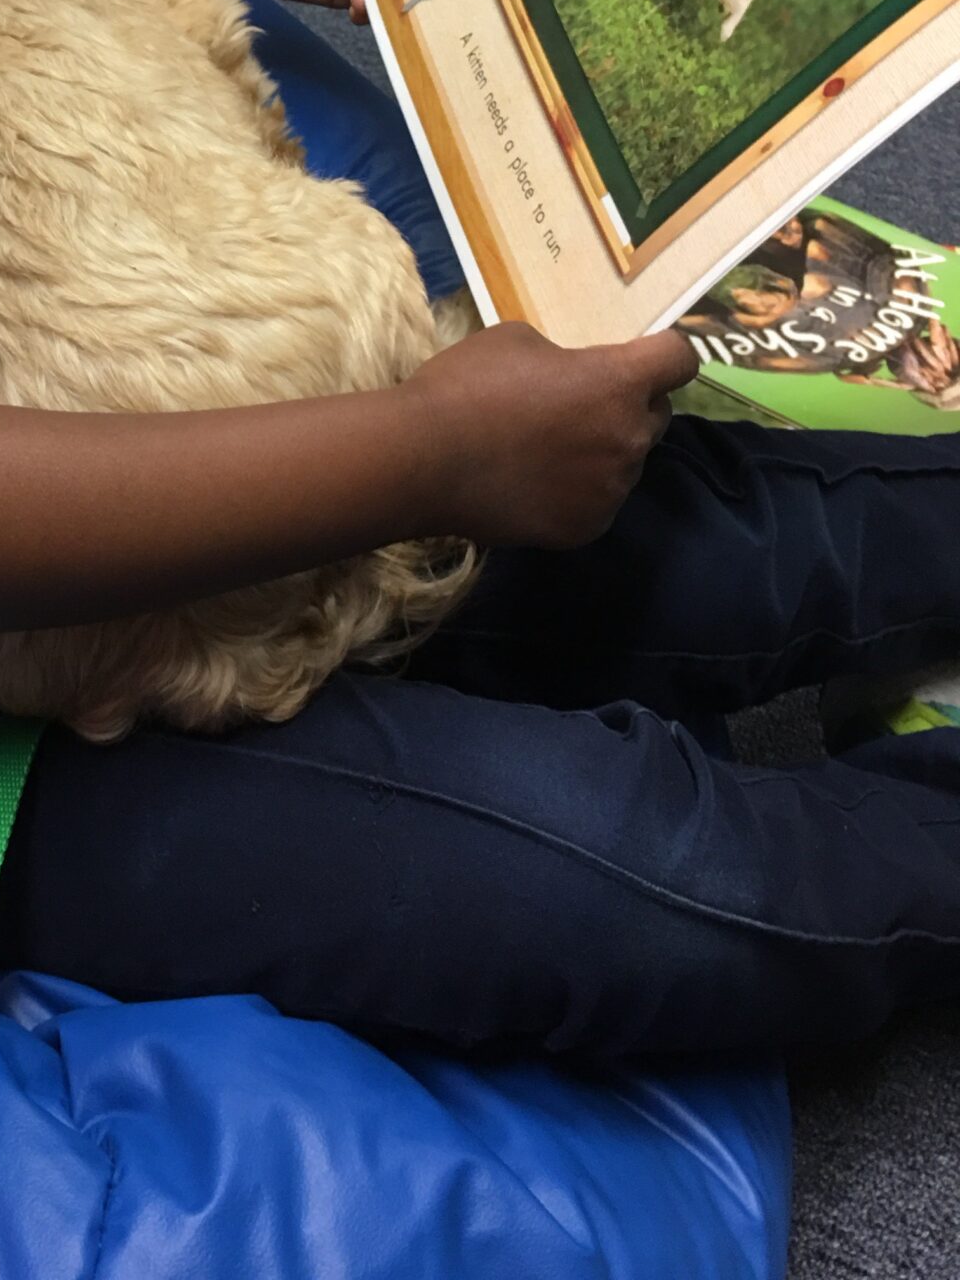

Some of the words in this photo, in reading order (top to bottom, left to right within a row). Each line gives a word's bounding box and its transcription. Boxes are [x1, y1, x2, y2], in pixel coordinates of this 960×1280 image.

[459, 32, 473, 49] A
[466, 46, 488, 90] kitten
[484, 92, 509, 136] needs
[503, 139, 515, 154] a
[508, 156, 535, 200] place
[532, 203, 547, 225] to
[542, 228, 563, 263] run.
[891, 243, 946, 282] At
[809, 306, 836, 324] a
[828, 285, 873, 308] in
[689, 320, 827, 366] Shell
[834, 287, 946, 363] Home
